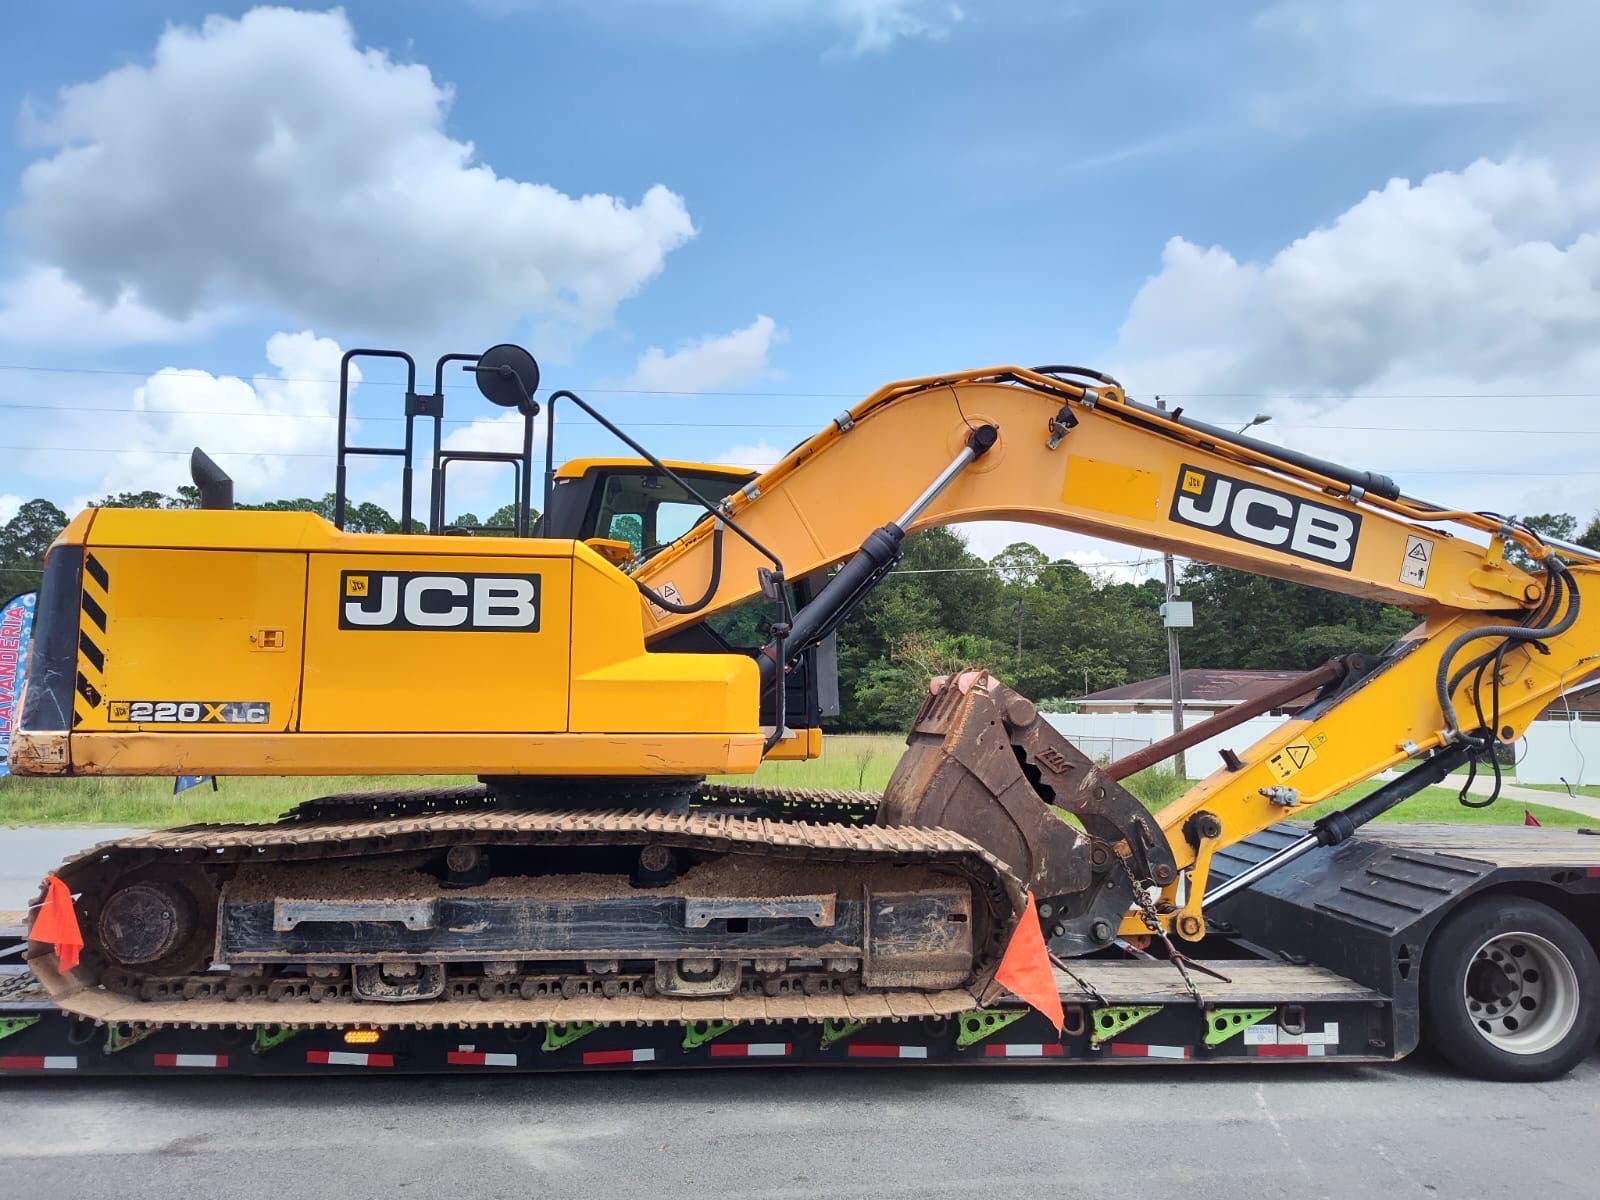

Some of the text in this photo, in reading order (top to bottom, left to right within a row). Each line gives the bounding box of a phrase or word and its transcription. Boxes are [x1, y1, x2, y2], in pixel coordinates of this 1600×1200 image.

[1178, 479, 1354, 563] JCB
[345, 576, 536, 627] JCB
[0, 606, 24, 733] LAVANDERIA
